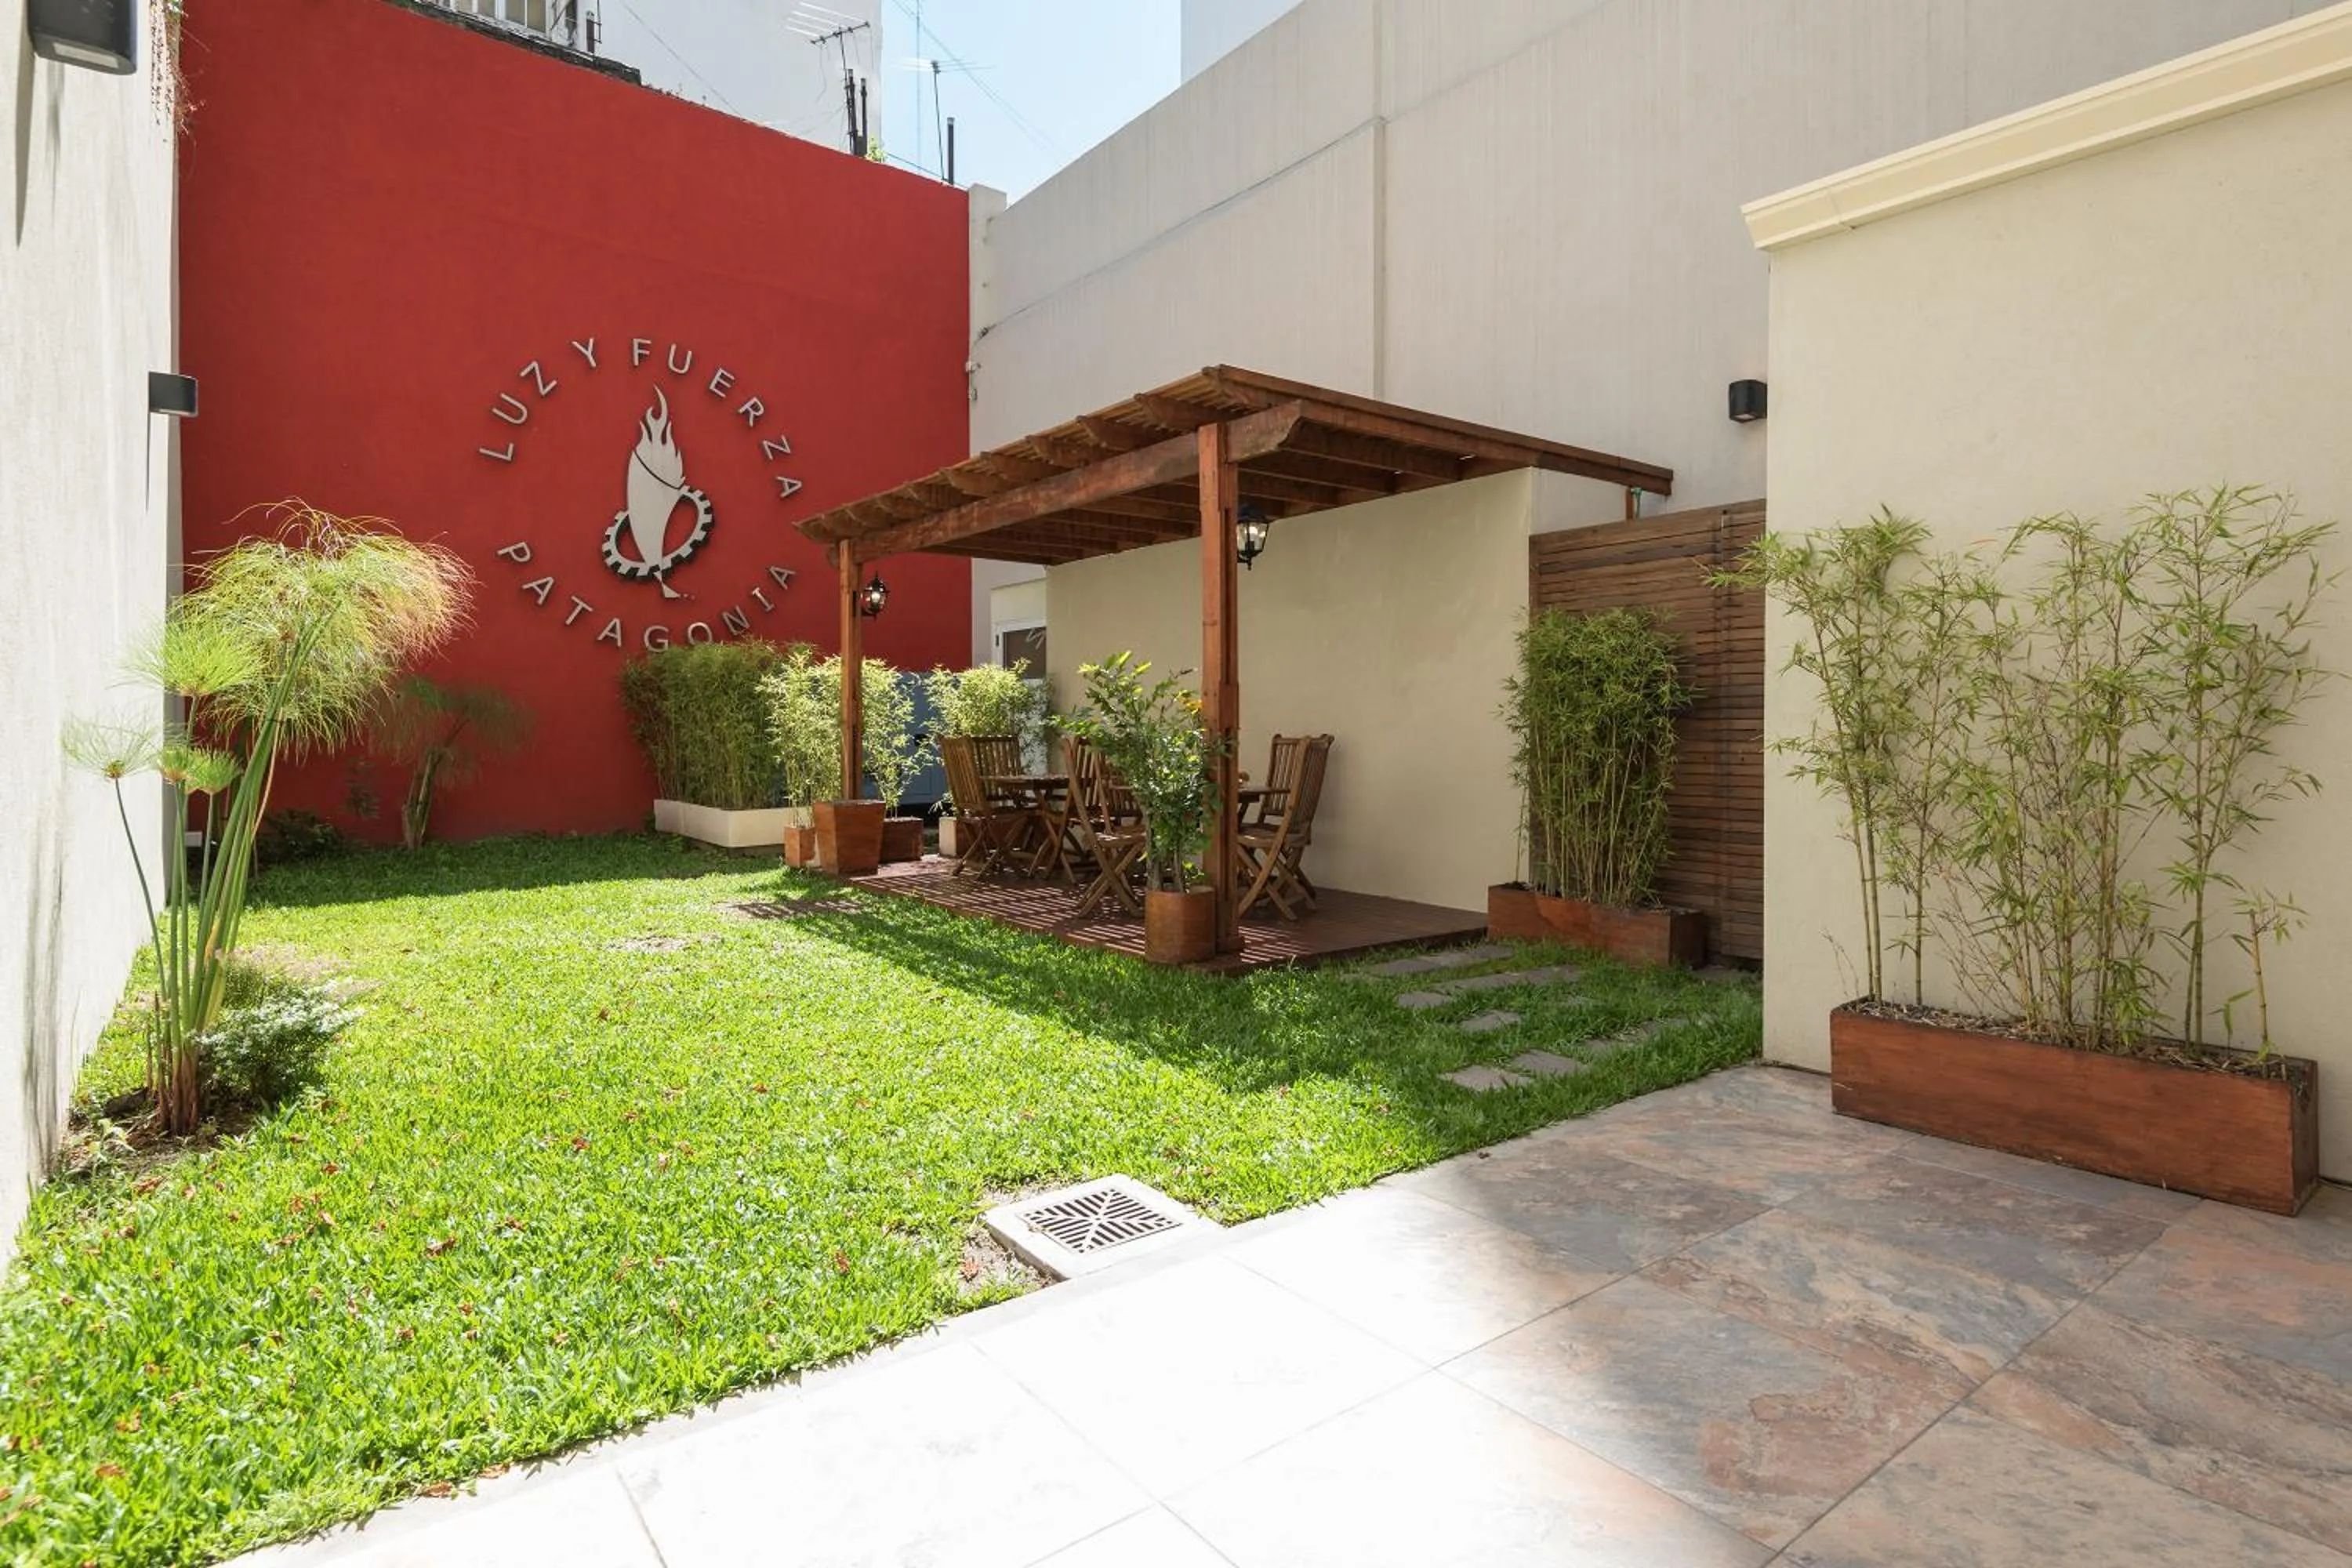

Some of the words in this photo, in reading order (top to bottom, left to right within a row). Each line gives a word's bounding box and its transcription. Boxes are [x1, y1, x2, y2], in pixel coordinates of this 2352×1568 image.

[479, 361, 557, 462] LUZ
[572, 338, 597, 368] Y
[633, 338, 803, 498] FUERZA
[497, 542, 796, 653] PATAGONIA
